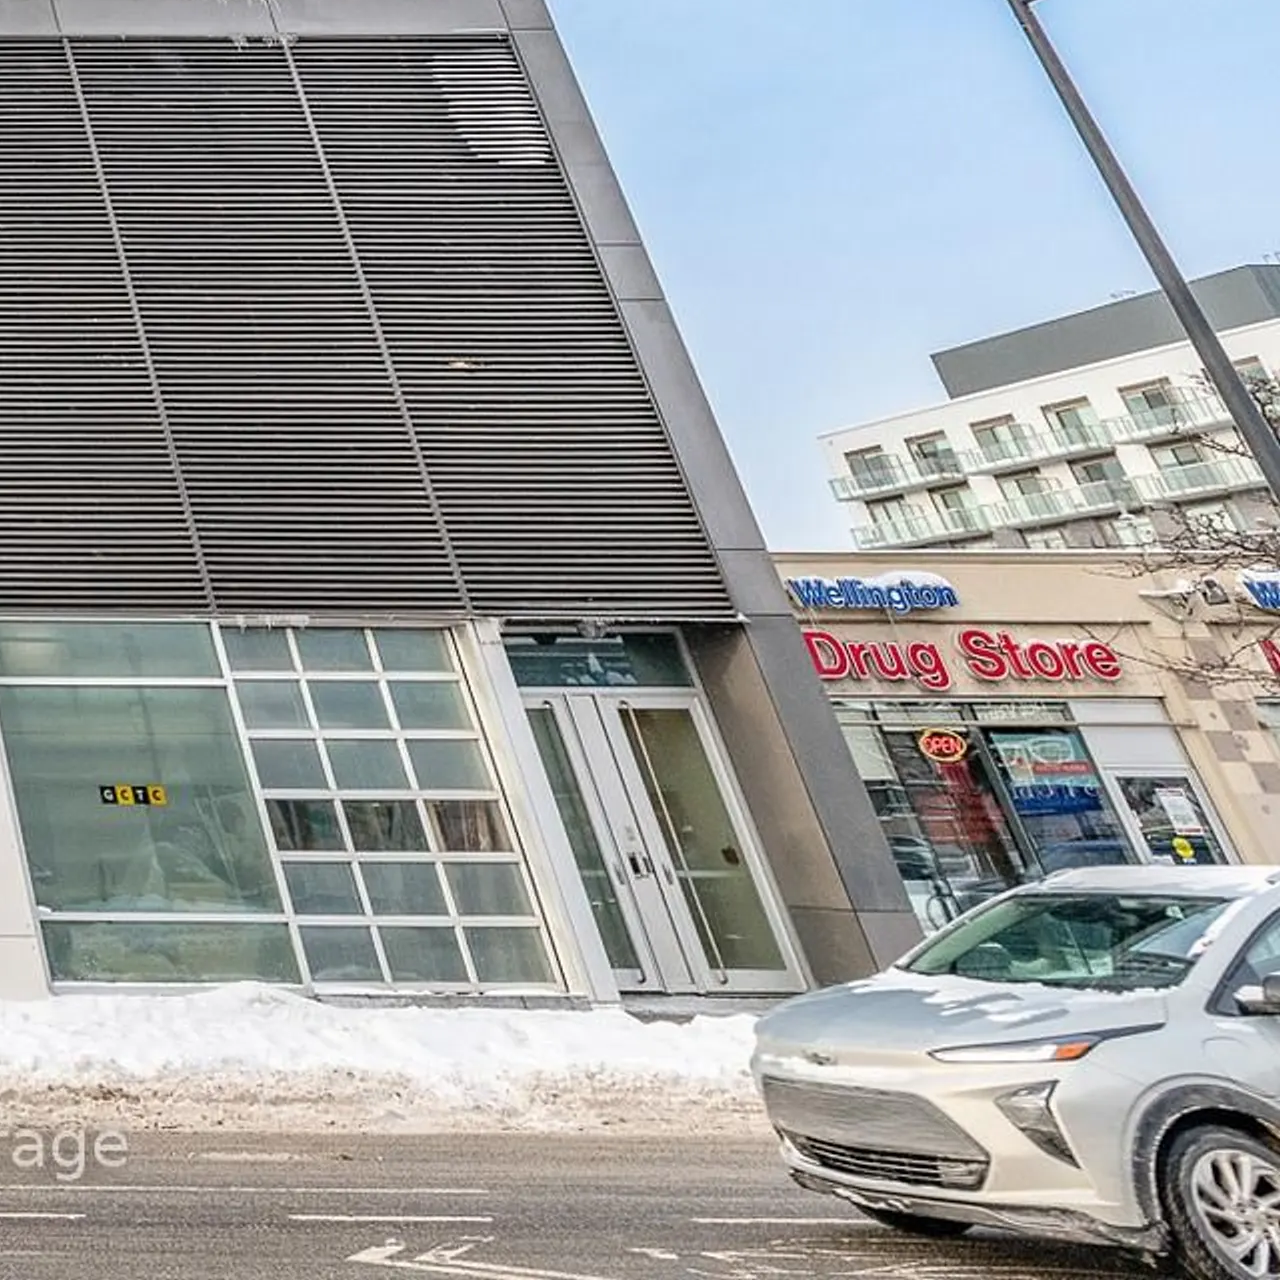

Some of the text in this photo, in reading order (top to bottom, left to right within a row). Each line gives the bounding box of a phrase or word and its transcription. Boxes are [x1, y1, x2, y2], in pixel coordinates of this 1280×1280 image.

[790, 577, 959, 614] Wellington
[802, 629, 1123, 691] Drug Store
[923, 736, 961, 753] OPEN
